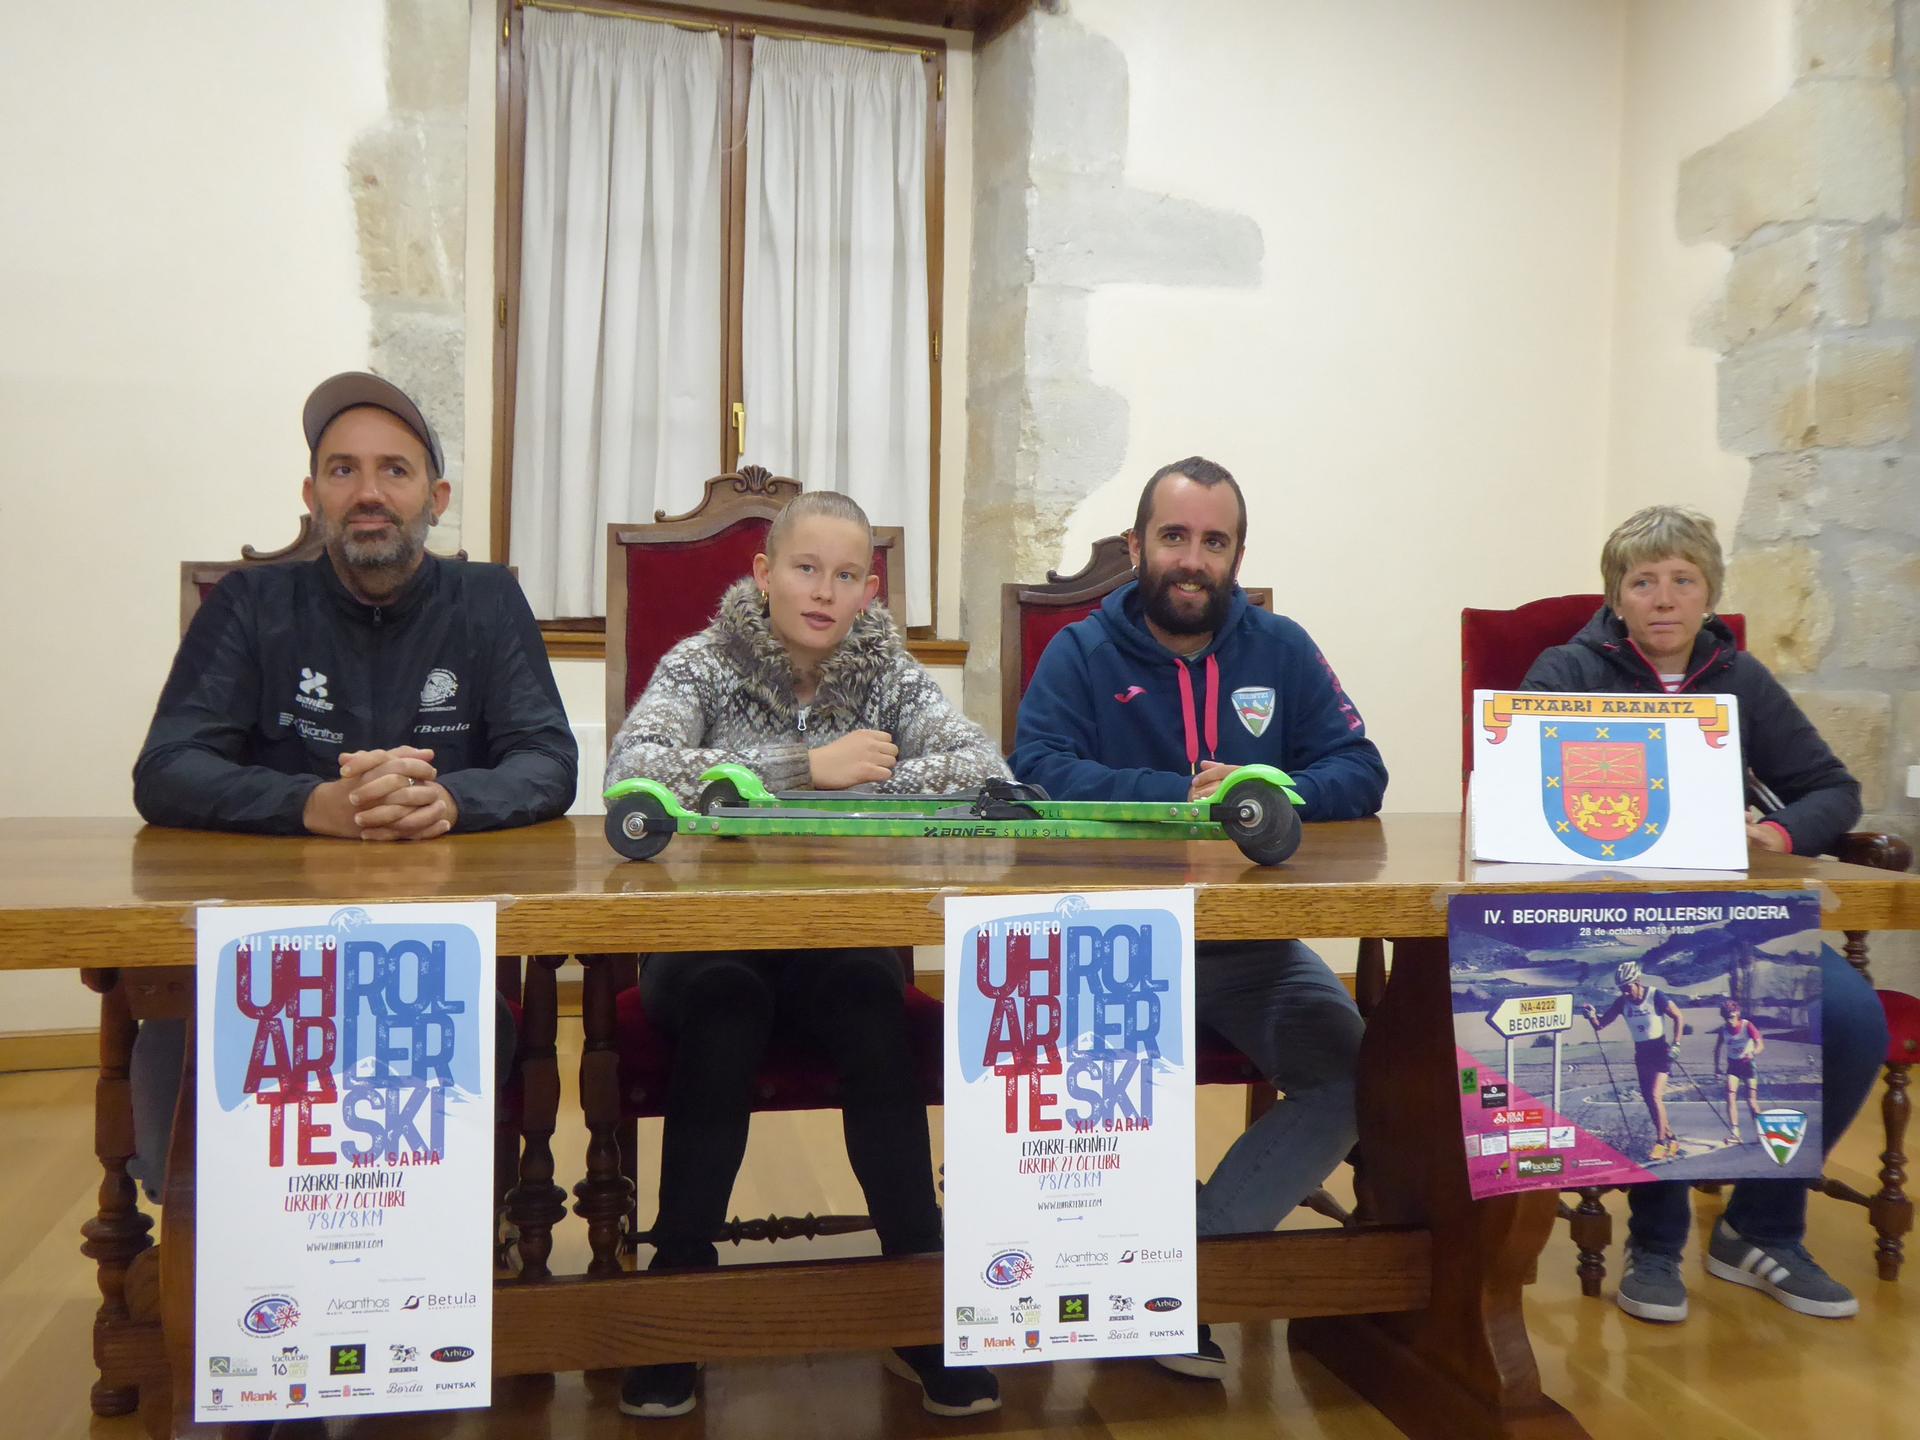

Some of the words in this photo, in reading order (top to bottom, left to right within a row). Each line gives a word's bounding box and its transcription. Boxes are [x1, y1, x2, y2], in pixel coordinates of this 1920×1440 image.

[1602, 700, 1695, 714] ARANATZ
[940, 825, 997, 837] BONES
[1004, 828, 1070, 838] SKIROLL
[1484, 909, 1506, 925] IV.
[1512, 907, 1628, 925] BEORBURUKO
[1634, 905, 1723, 922] ROLLERSKI
[1729, 904, 1790, 921] IGOERA
[978, 922, 999, 938] XII
[1004, 920, 1062, 936] TROFEO
[1579, 927, 1592, 936] 28
[1594, 926, 1606, 936] de
[1608, 925, 1643, 936] octubre
[237, 936, 262, 952] XII
[268, 934, 337, 951] TROFEO
[1520, 1000, 1556, 1012] NA-4222
[1509, 1014, 1567, 1032] BEORBURU
[1074, 1121, 1099, 1134] XII.
[1105, 1117, 1151, 1132] SARIA
[352, 1154, 381, 1168] XII.
[387, 1151, 440, 1167] SARIA
[1019, 1157, 1059, 1174] URRIAK
[1061, 1155, 1073, 1172] 27
[1076, 1153, 1120, 1171] OCTUBRE
[1083, 1171, 1102, 1187] KM
[284, 1193, 332, 1212] URRIAK
[335, 1192, 349, 1210] 27
[353, 1190, 406, 1209] OCTUBRE
[361, 1209, 384, 1228] KM
[1055, 1251, 1109, 1264] Akanthos
[1140, 1248, 1183, 1260] Betula
[327, 1297, 390, 1311] Akanthos
[428, 1292, 477, 1306] Betula
[1107, 1329, 1138, 1340] Borda
[1149, 1330, 1185, 1338] FUNTSAK
[983, 1337, 1016, 1348] Mank
[386, 1381, 424, 1394] Borda
[435, 1381, 477, 1391] FUNTSAK
[241, 1390, 277, 1402] Mank
